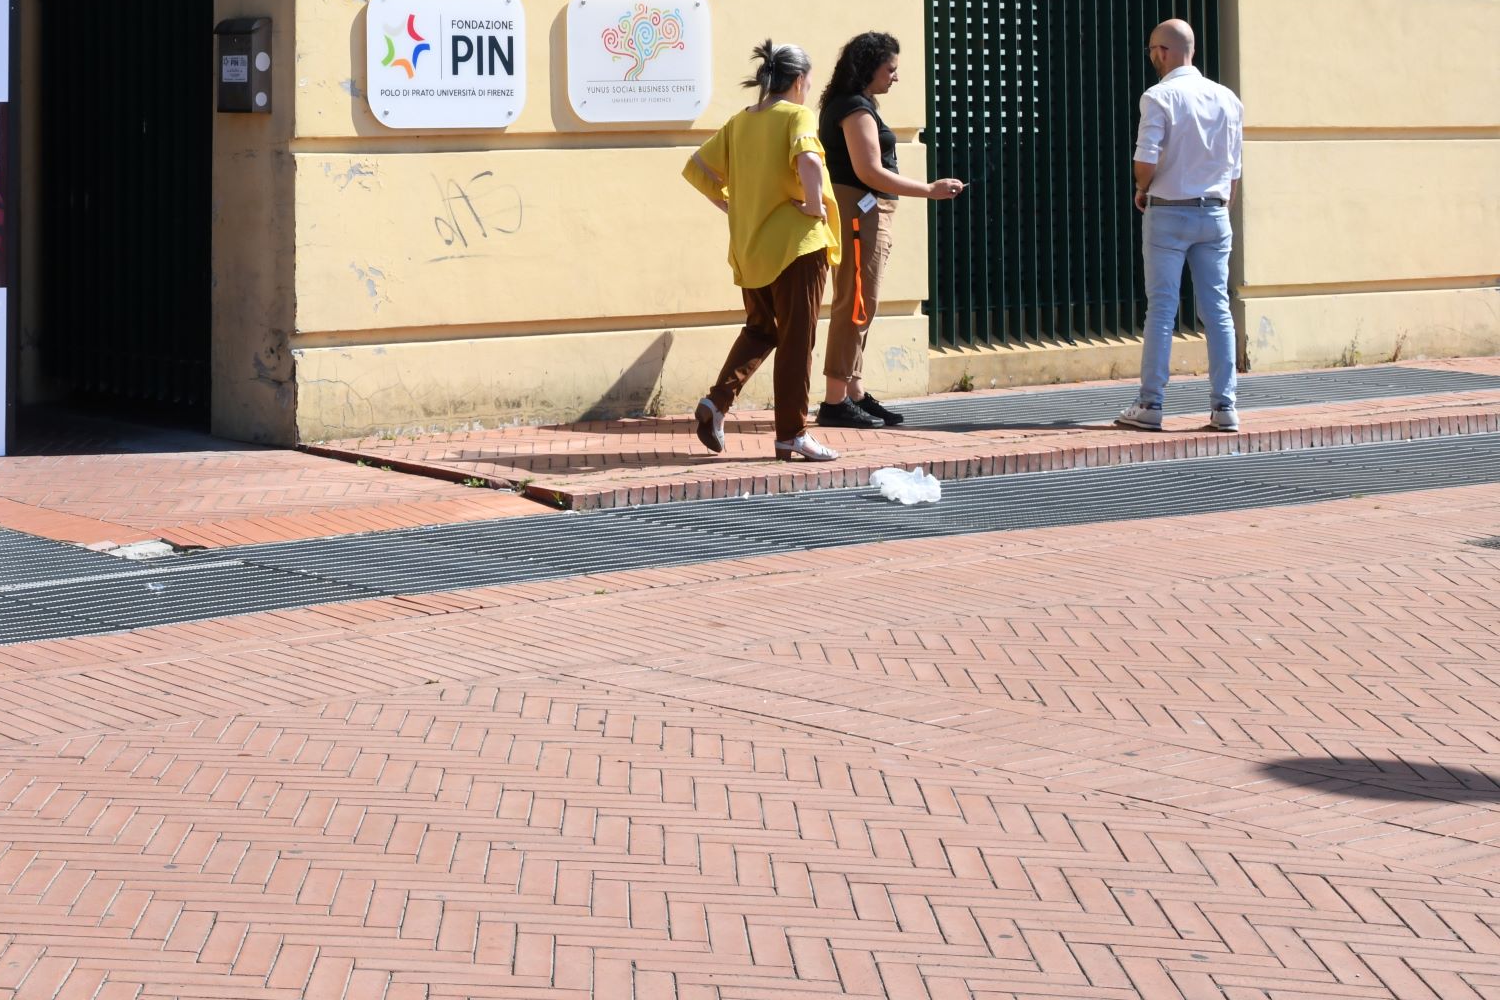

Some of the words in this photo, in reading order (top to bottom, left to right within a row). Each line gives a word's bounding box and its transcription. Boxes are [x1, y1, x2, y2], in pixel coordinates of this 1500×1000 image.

[451, 20, 514, 30] FONDAZIONE
[452, 35, 514, 75] PIN
[381, 89, 401, 97] POLO
[402, 89, 410, 97] DI
[411, 89, 435, 97] PRATO
[436, 87, 478, 97] UNIVERSITÀ
[478, 89, 486, 97] DI
[487, 89, 514, 97] FIRENZE
[587, 86, 610, 94] YUNUS
[638, 85, 670, 93] BUSINESS
